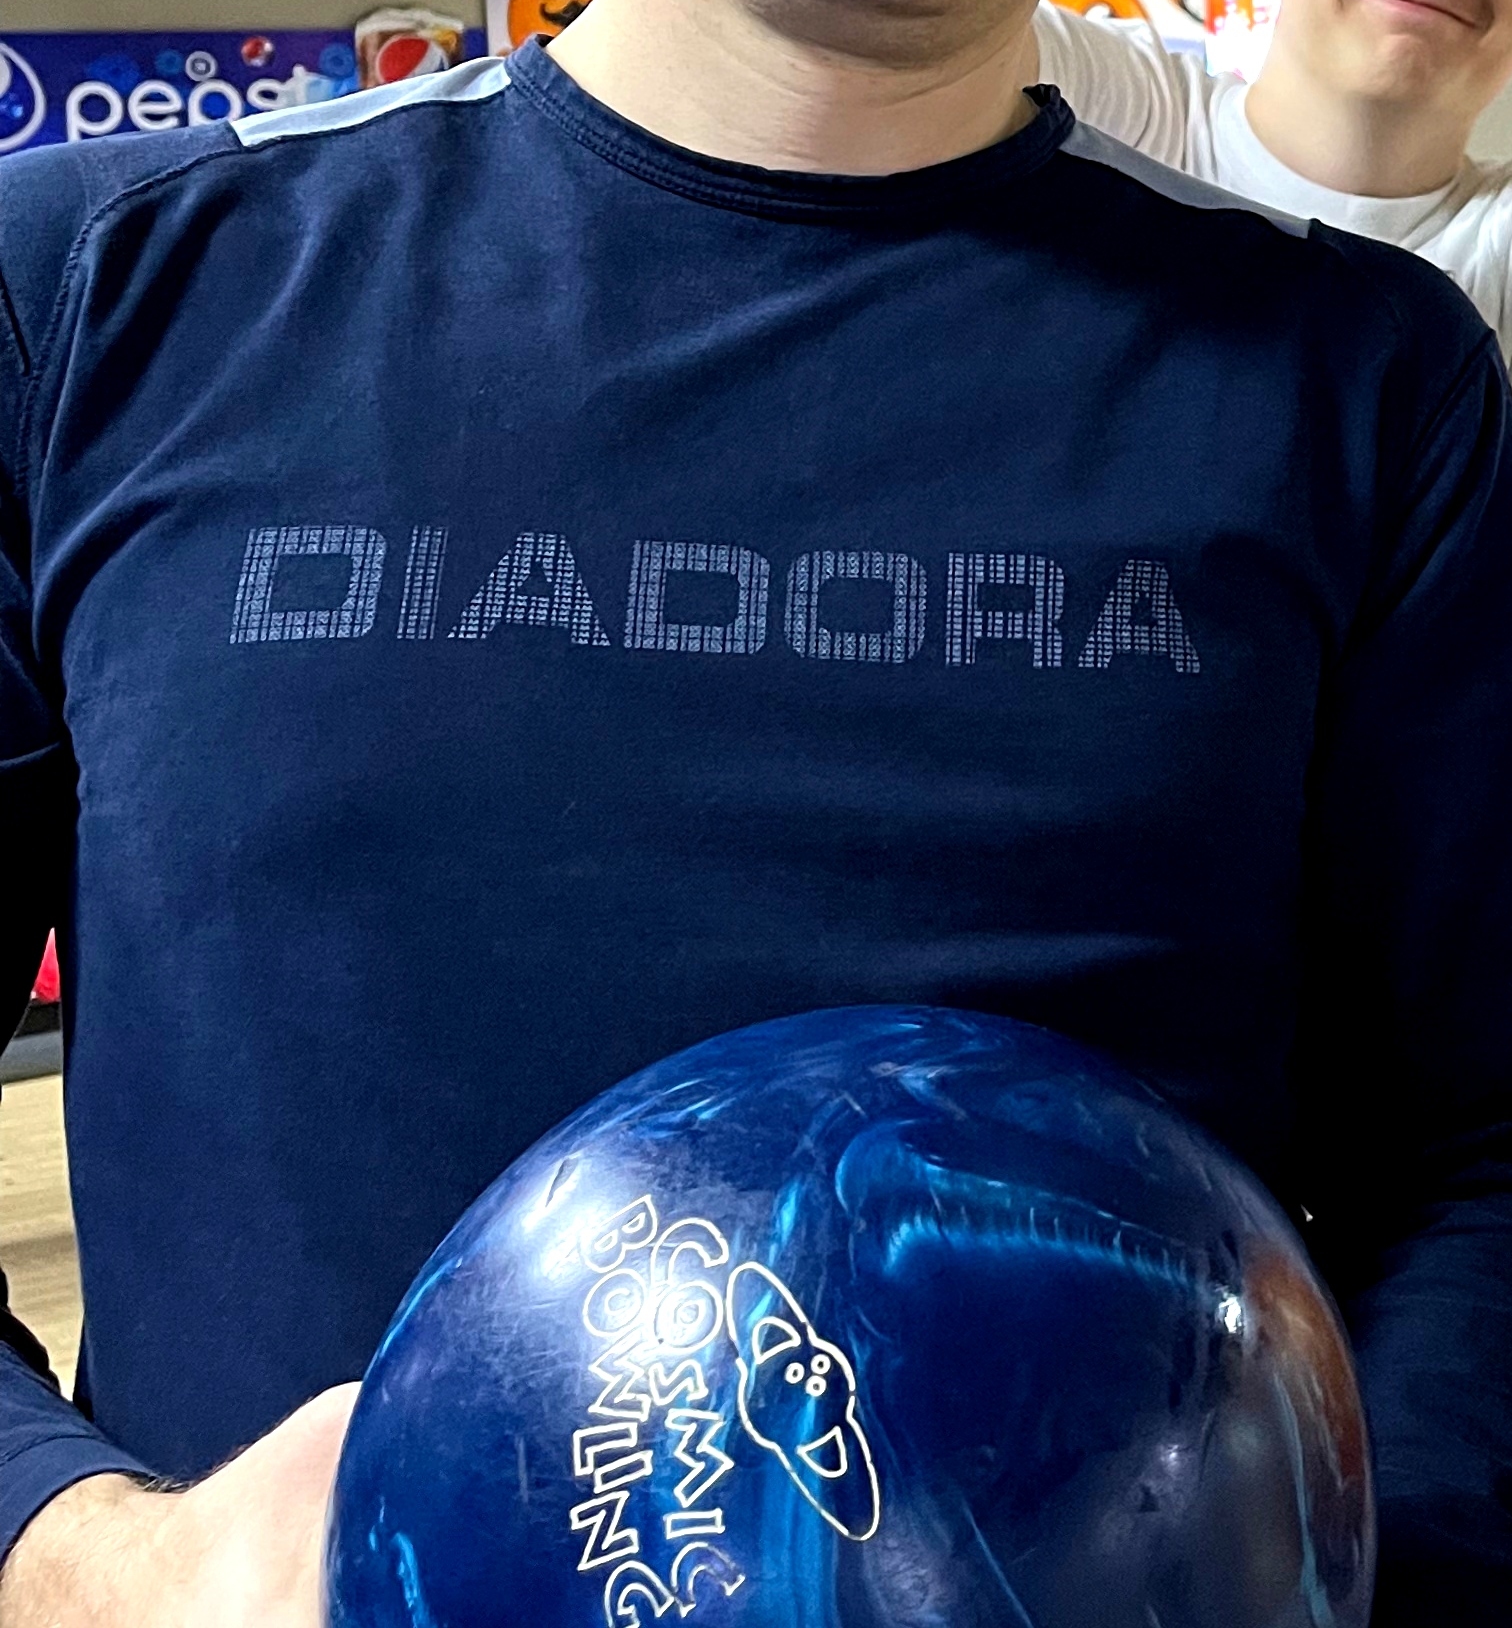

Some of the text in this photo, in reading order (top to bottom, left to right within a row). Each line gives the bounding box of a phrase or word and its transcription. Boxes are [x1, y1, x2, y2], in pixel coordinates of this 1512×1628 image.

[229, 523, 1201, 673] DIADORA
[570, 1194, 674, 1628] BOWLING
[648, 1217, 745, 1618] COSMIC
